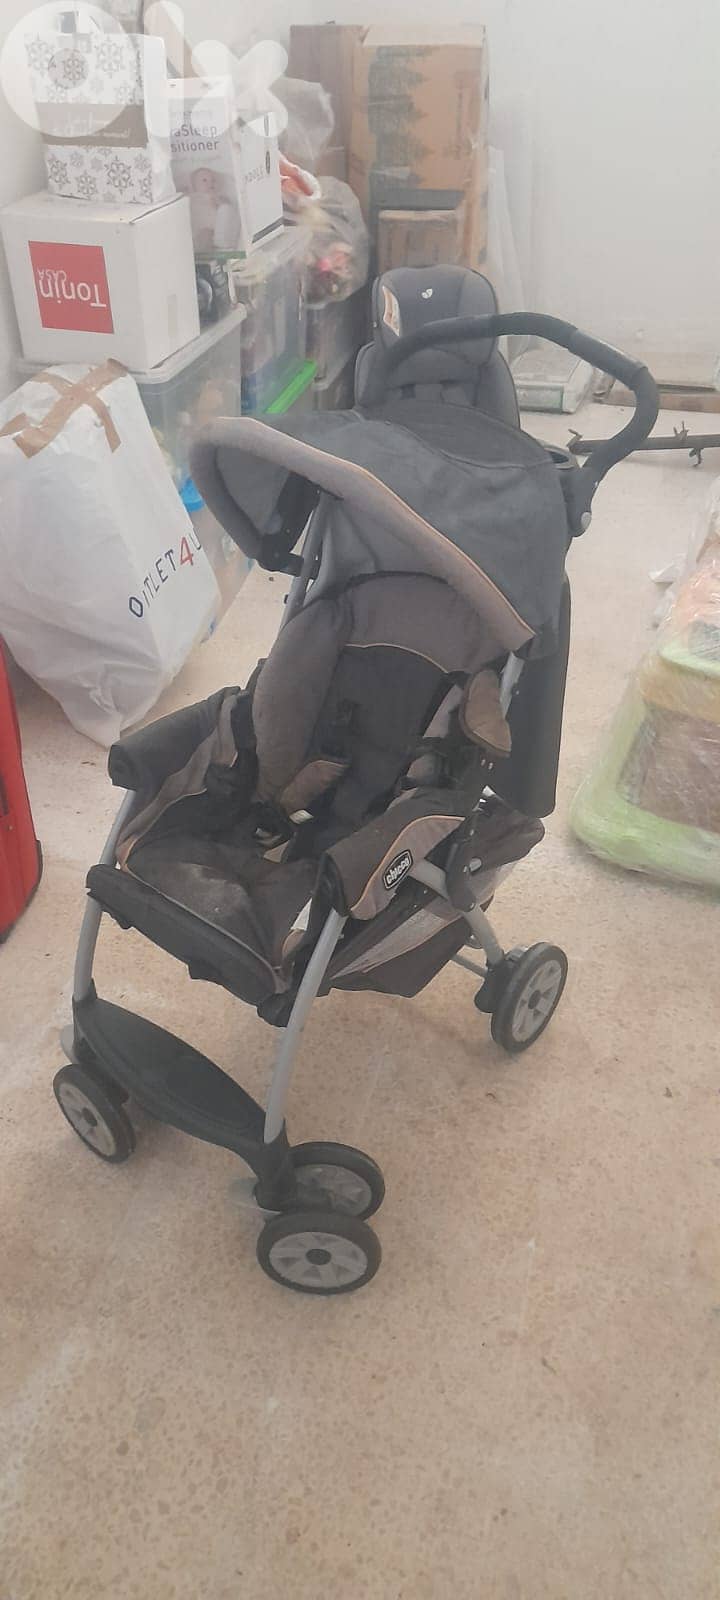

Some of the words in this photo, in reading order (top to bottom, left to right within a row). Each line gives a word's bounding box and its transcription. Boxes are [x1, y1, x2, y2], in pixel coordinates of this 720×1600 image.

[37, 267, 67, 281] CASA
[36, 279, 107, 307] Tonin
[386, 857, 410, 884] chicco
